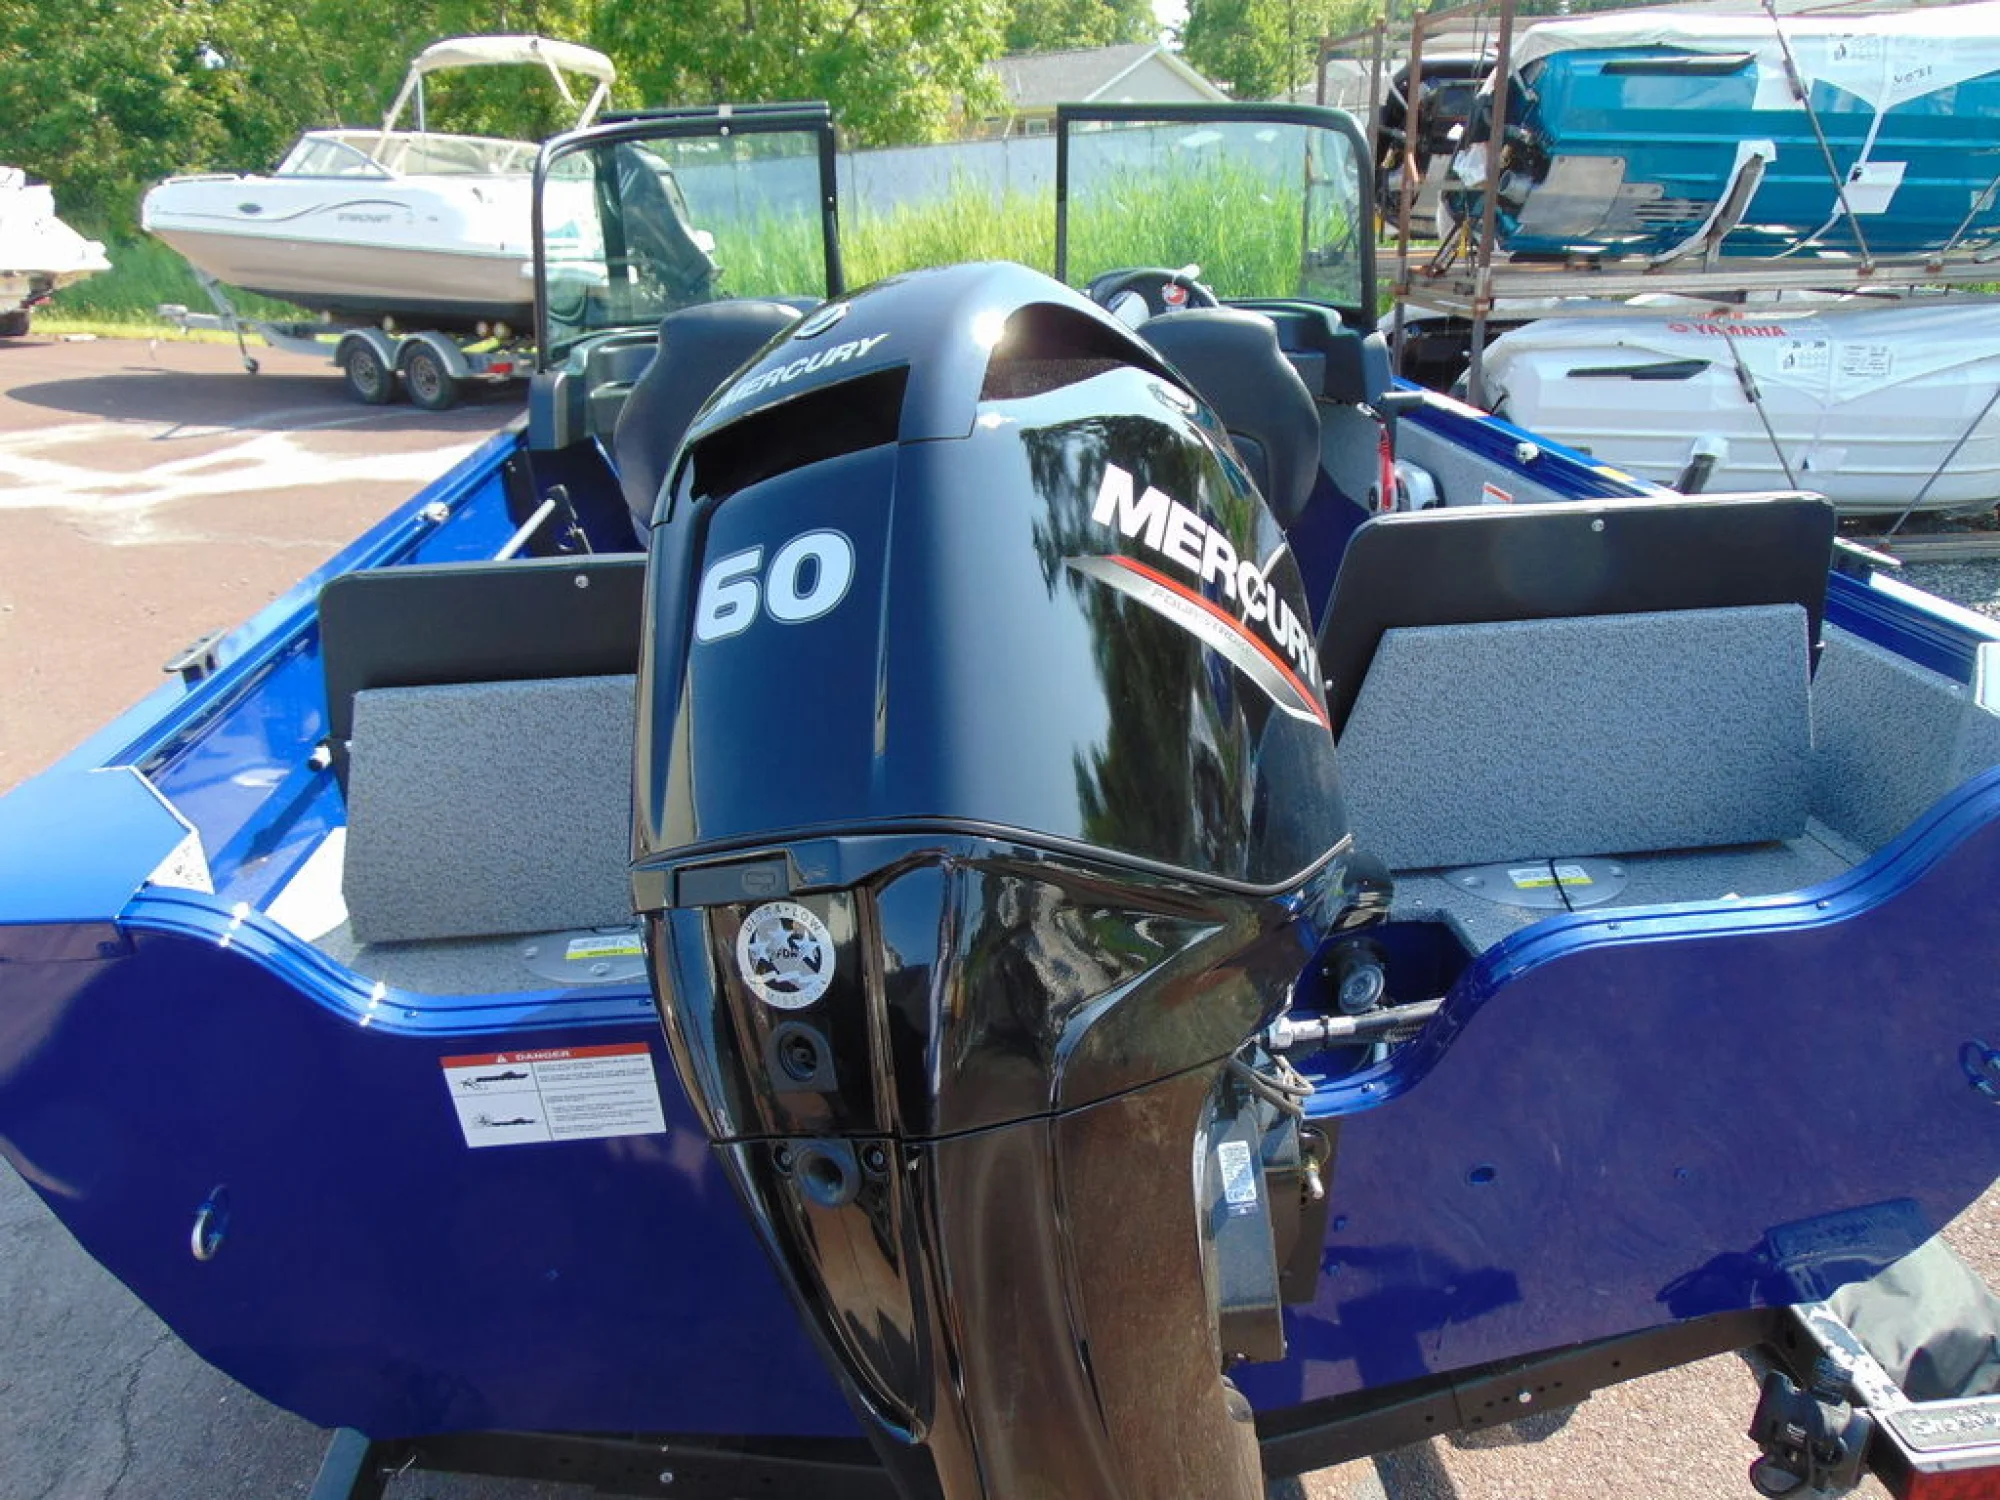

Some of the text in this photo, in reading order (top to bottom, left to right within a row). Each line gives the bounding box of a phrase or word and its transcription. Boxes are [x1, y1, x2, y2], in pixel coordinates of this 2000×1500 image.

[716, 331, 893, 410] MERCURY
[694, 527, 857, 646] 60
[1091, 461, 1320, 688] MERCURY
[515, 1050, 572, 1063] DANGER
